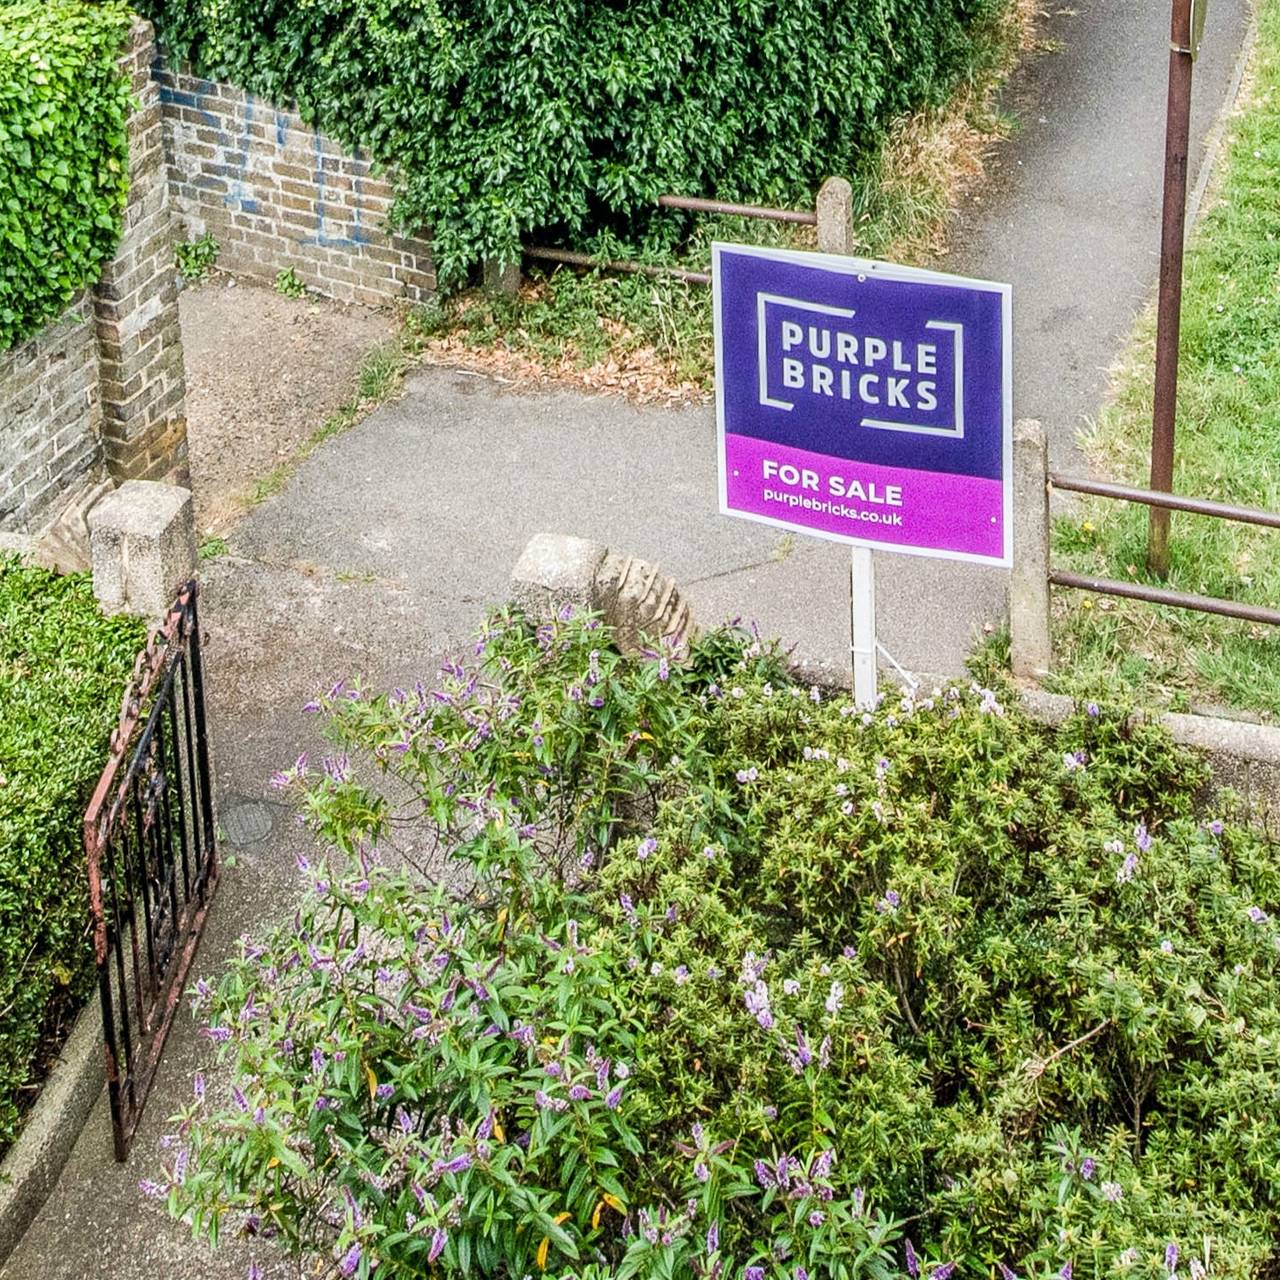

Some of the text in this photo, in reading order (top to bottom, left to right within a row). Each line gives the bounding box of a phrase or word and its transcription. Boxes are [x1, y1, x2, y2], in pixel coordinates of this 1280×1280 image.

[782, 321, 937, 374] PURPLE
[782, 358, 938, 411] BRICKS
[762, 460, 903, 506] FOR SALE
[764, 488, 903, 526] purplebricks.co.uk
